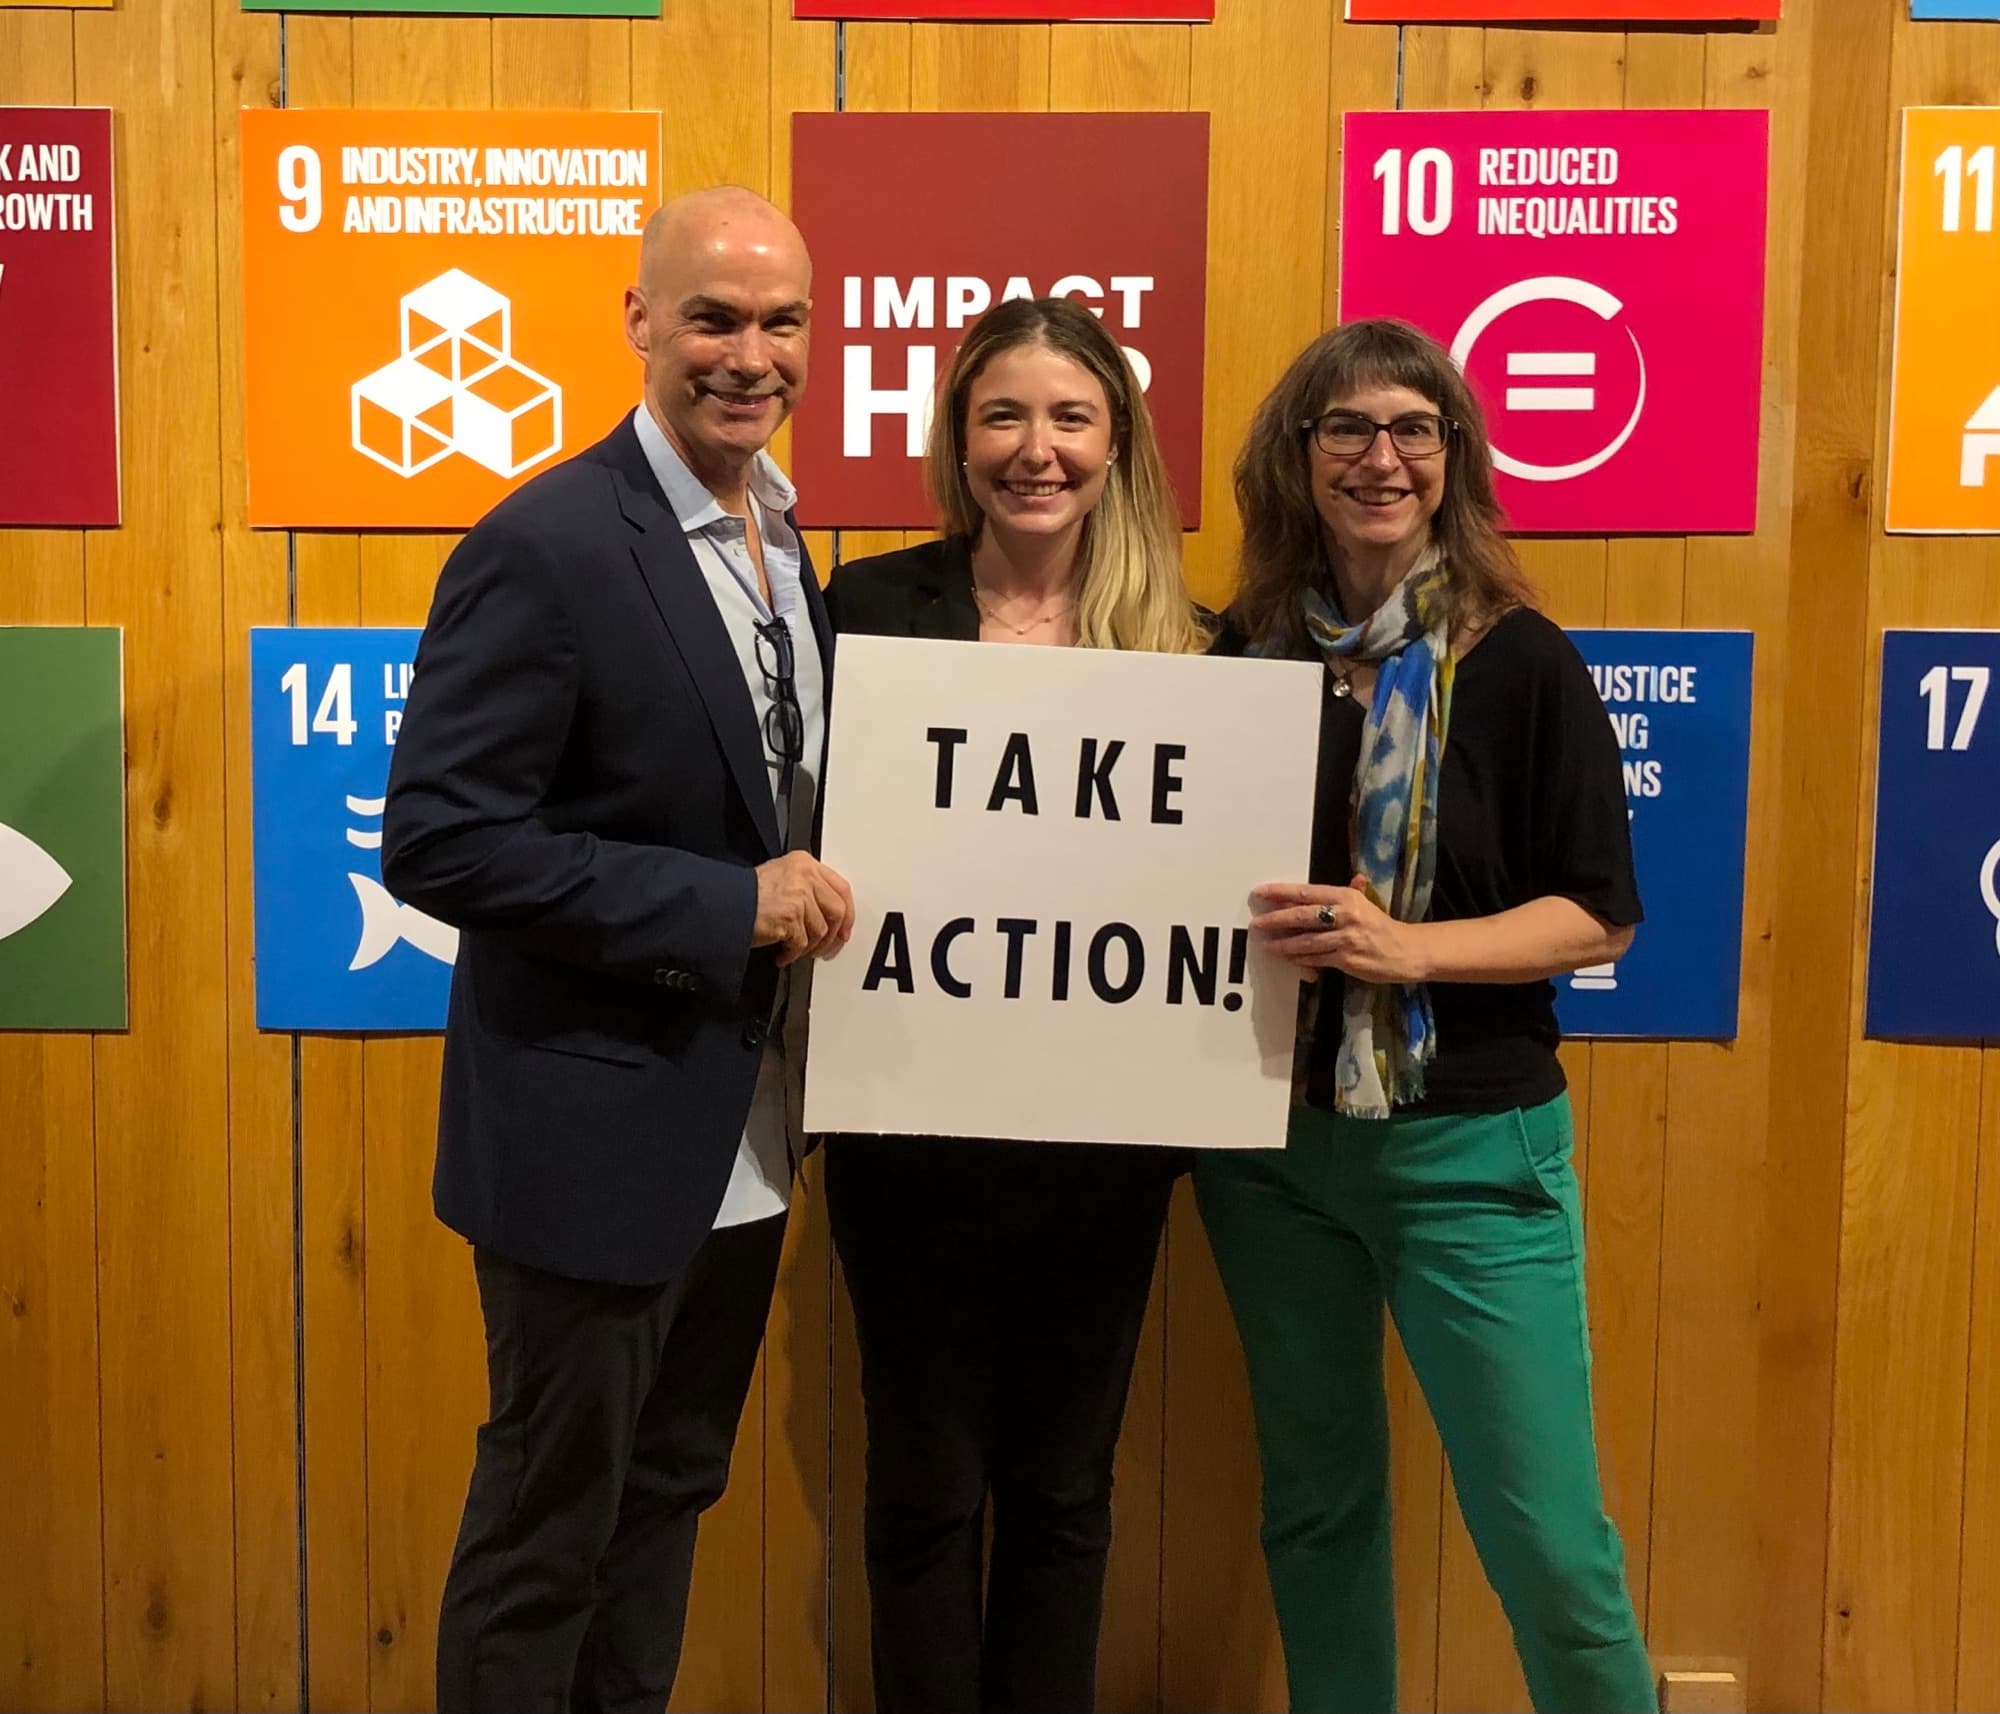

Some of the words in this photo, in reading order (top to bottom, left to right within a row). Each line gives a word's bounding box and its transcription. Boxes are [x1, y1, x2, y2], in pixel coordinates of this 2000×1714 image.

[18, 144, 81, 182] AND
[278, 145, 322, 232] 9
[342, 147, 482, 187] INDUSTRY,
[486, 148, 648, 187] INNOVATION
[1373, 147, 1453, 236] 10
[1478, 147, 1619, 186] REDUCED
[1934, 145, 1995, 232] 11
[343, 196, 402, 233] AND
[405, 197, 643, 236] INFRASTRUCTURE
[1477, 196, 1679, 239] INEQUALITIES
[281, 663, 358, 745] 14
[384, 663, 415, 699] LI
[1586, 665, 1697, 703] USTICE
[1920, 666, 1990, 750] 17
[926, 727, 1187, 825] TAKE
[862, 911, 1248, 1012] ACTION!
